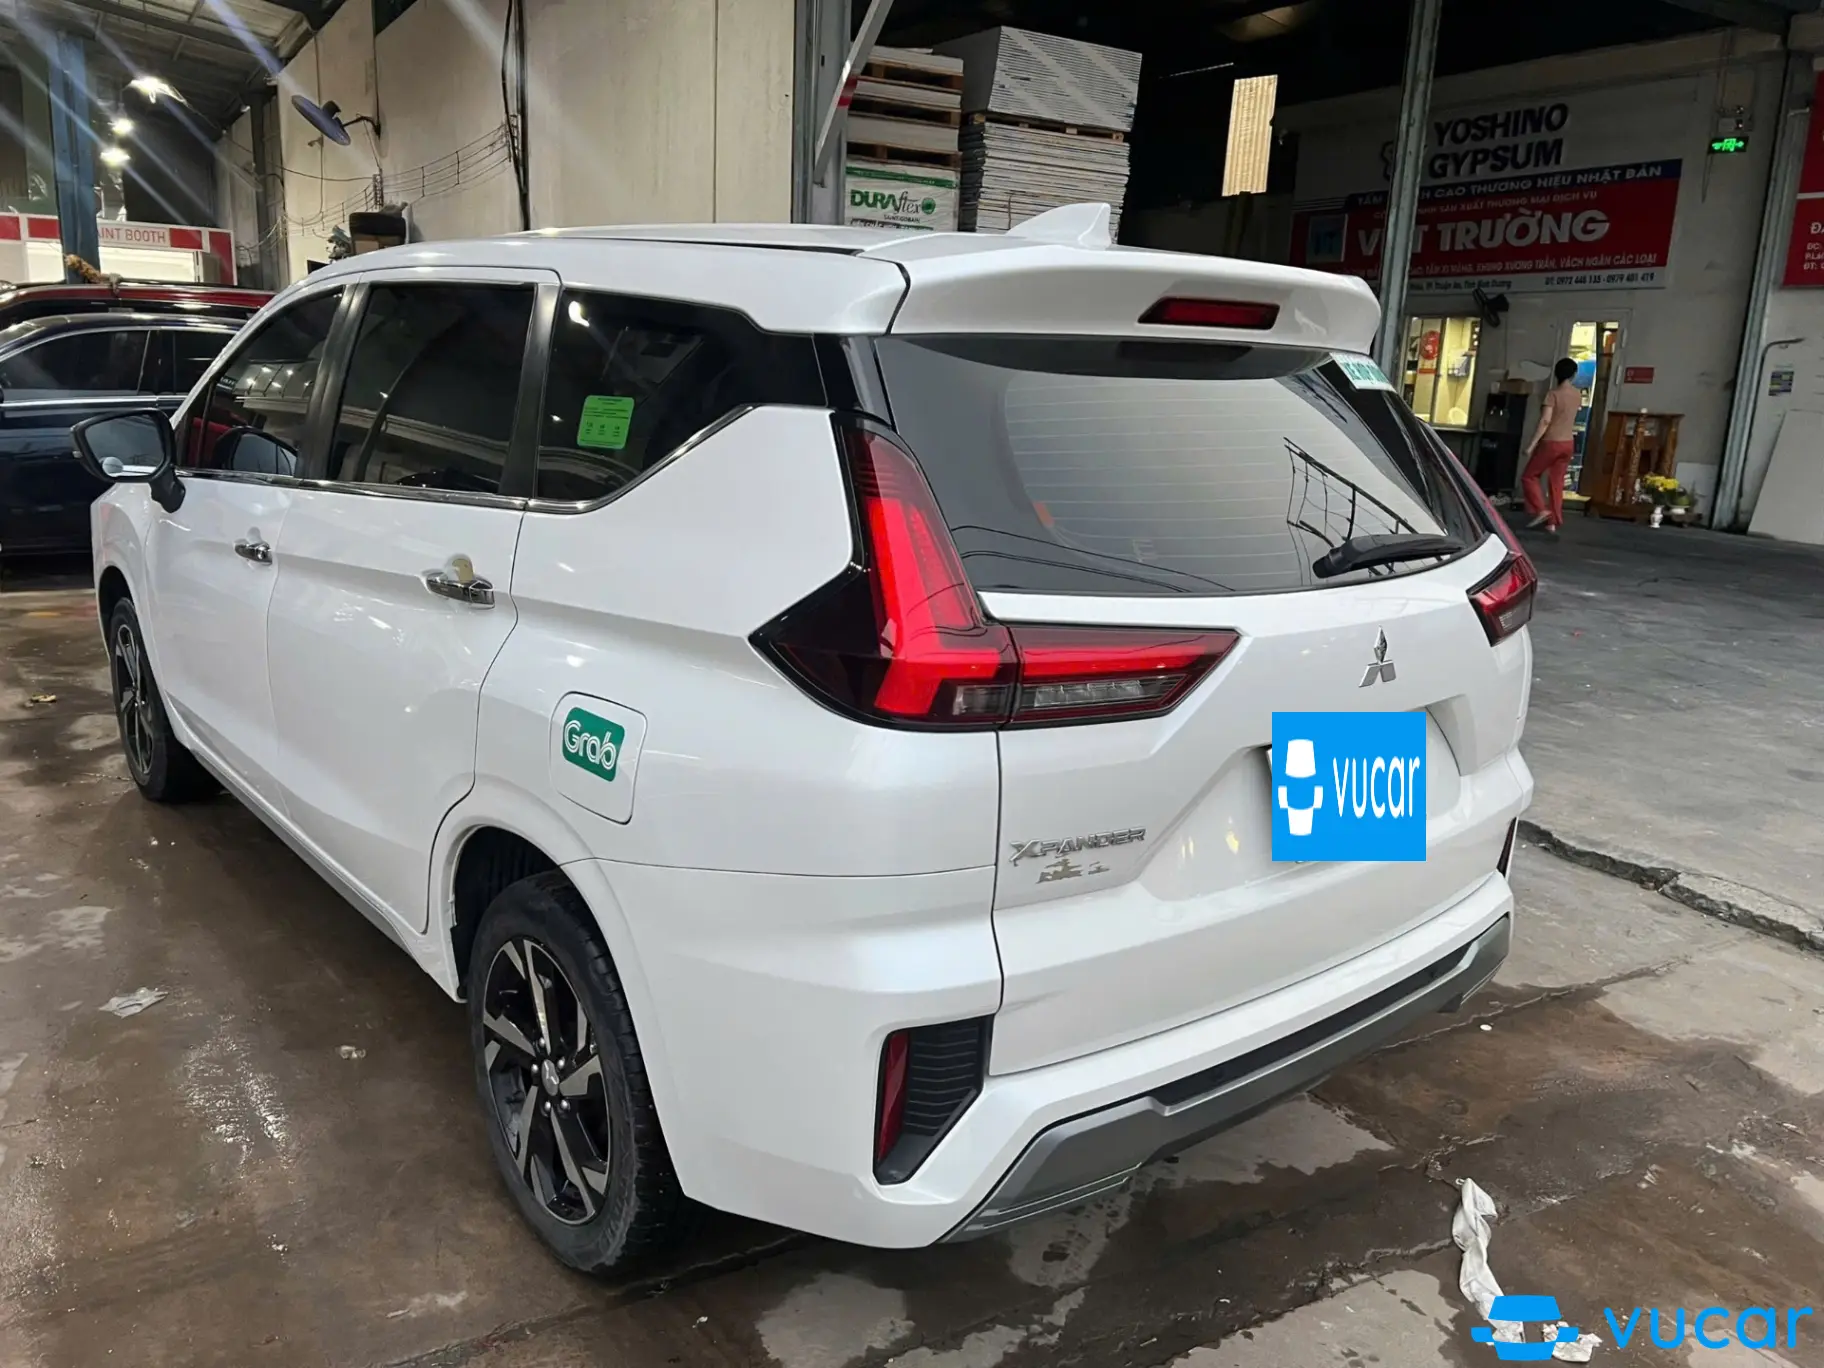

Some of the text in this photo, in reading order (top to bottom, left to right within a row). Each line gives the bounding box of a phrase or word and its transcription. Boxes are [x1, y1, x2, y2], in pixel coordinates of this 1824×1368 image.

[1434, 103, 1569, 147] YOSHINO
[1429, 139, 1564, 179] GYPSUM
[125, 229, 166, 243] BOOTH
[1438, 209, 1610, 252] TRƯỜNG
[564, 720, 617, 770] Grab
[1009, 826, 1146, 867] XPANDER
